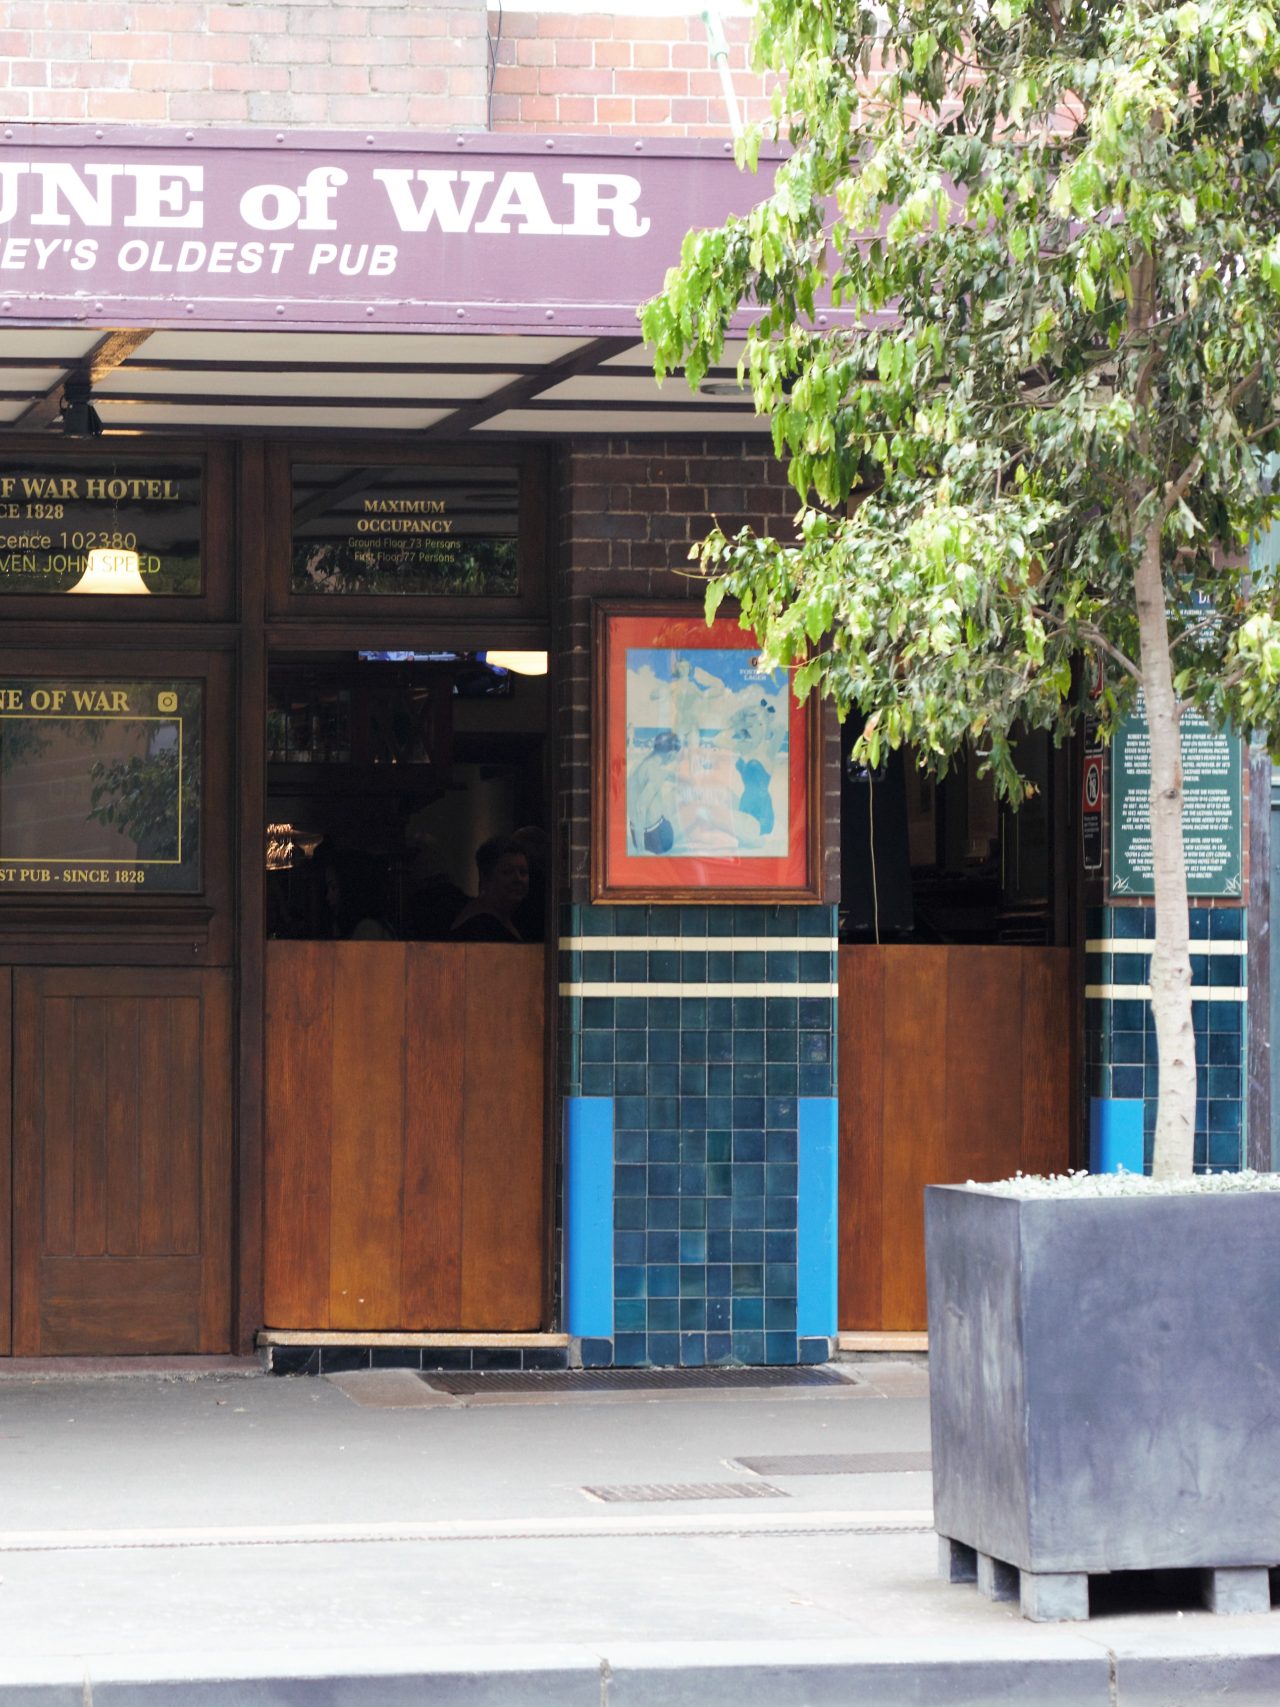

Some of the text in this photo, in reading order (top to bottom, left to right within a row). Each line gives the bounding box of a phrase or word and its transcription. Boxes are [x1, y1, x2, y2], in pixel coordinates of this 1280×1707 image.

[239, 166, 349, 231] of
[373, 168, 651, 238] WAR
[118, 240, 294, 273] OLDEST
[308, 244, 399, 276] PUB
[21, 478, 80, 499] WAR
[86, 479, 179, 499] HOTEL
[26, 504, 64, 519] 1828
[364, 500, 446, 513] MAXIMUM
[357, 519, 453, 533] OCCUPANCY
[60, 532, 137, 550] 102380
[348, 537, 381, 548] Ground
[384, 538, 406, 548] Floor
[425, 539, 461, 549] Persons
[43, 555, 94, 573] JOHN
[419, 553, 455, 562] Persons
[30, 690, 67, 711] OF
[72, 690, 131, 711] WAR
[20, 870, 51, 881] PUB
[63, 870, 110, 882] SINCE
[115, 870, 145, 883] 1828
